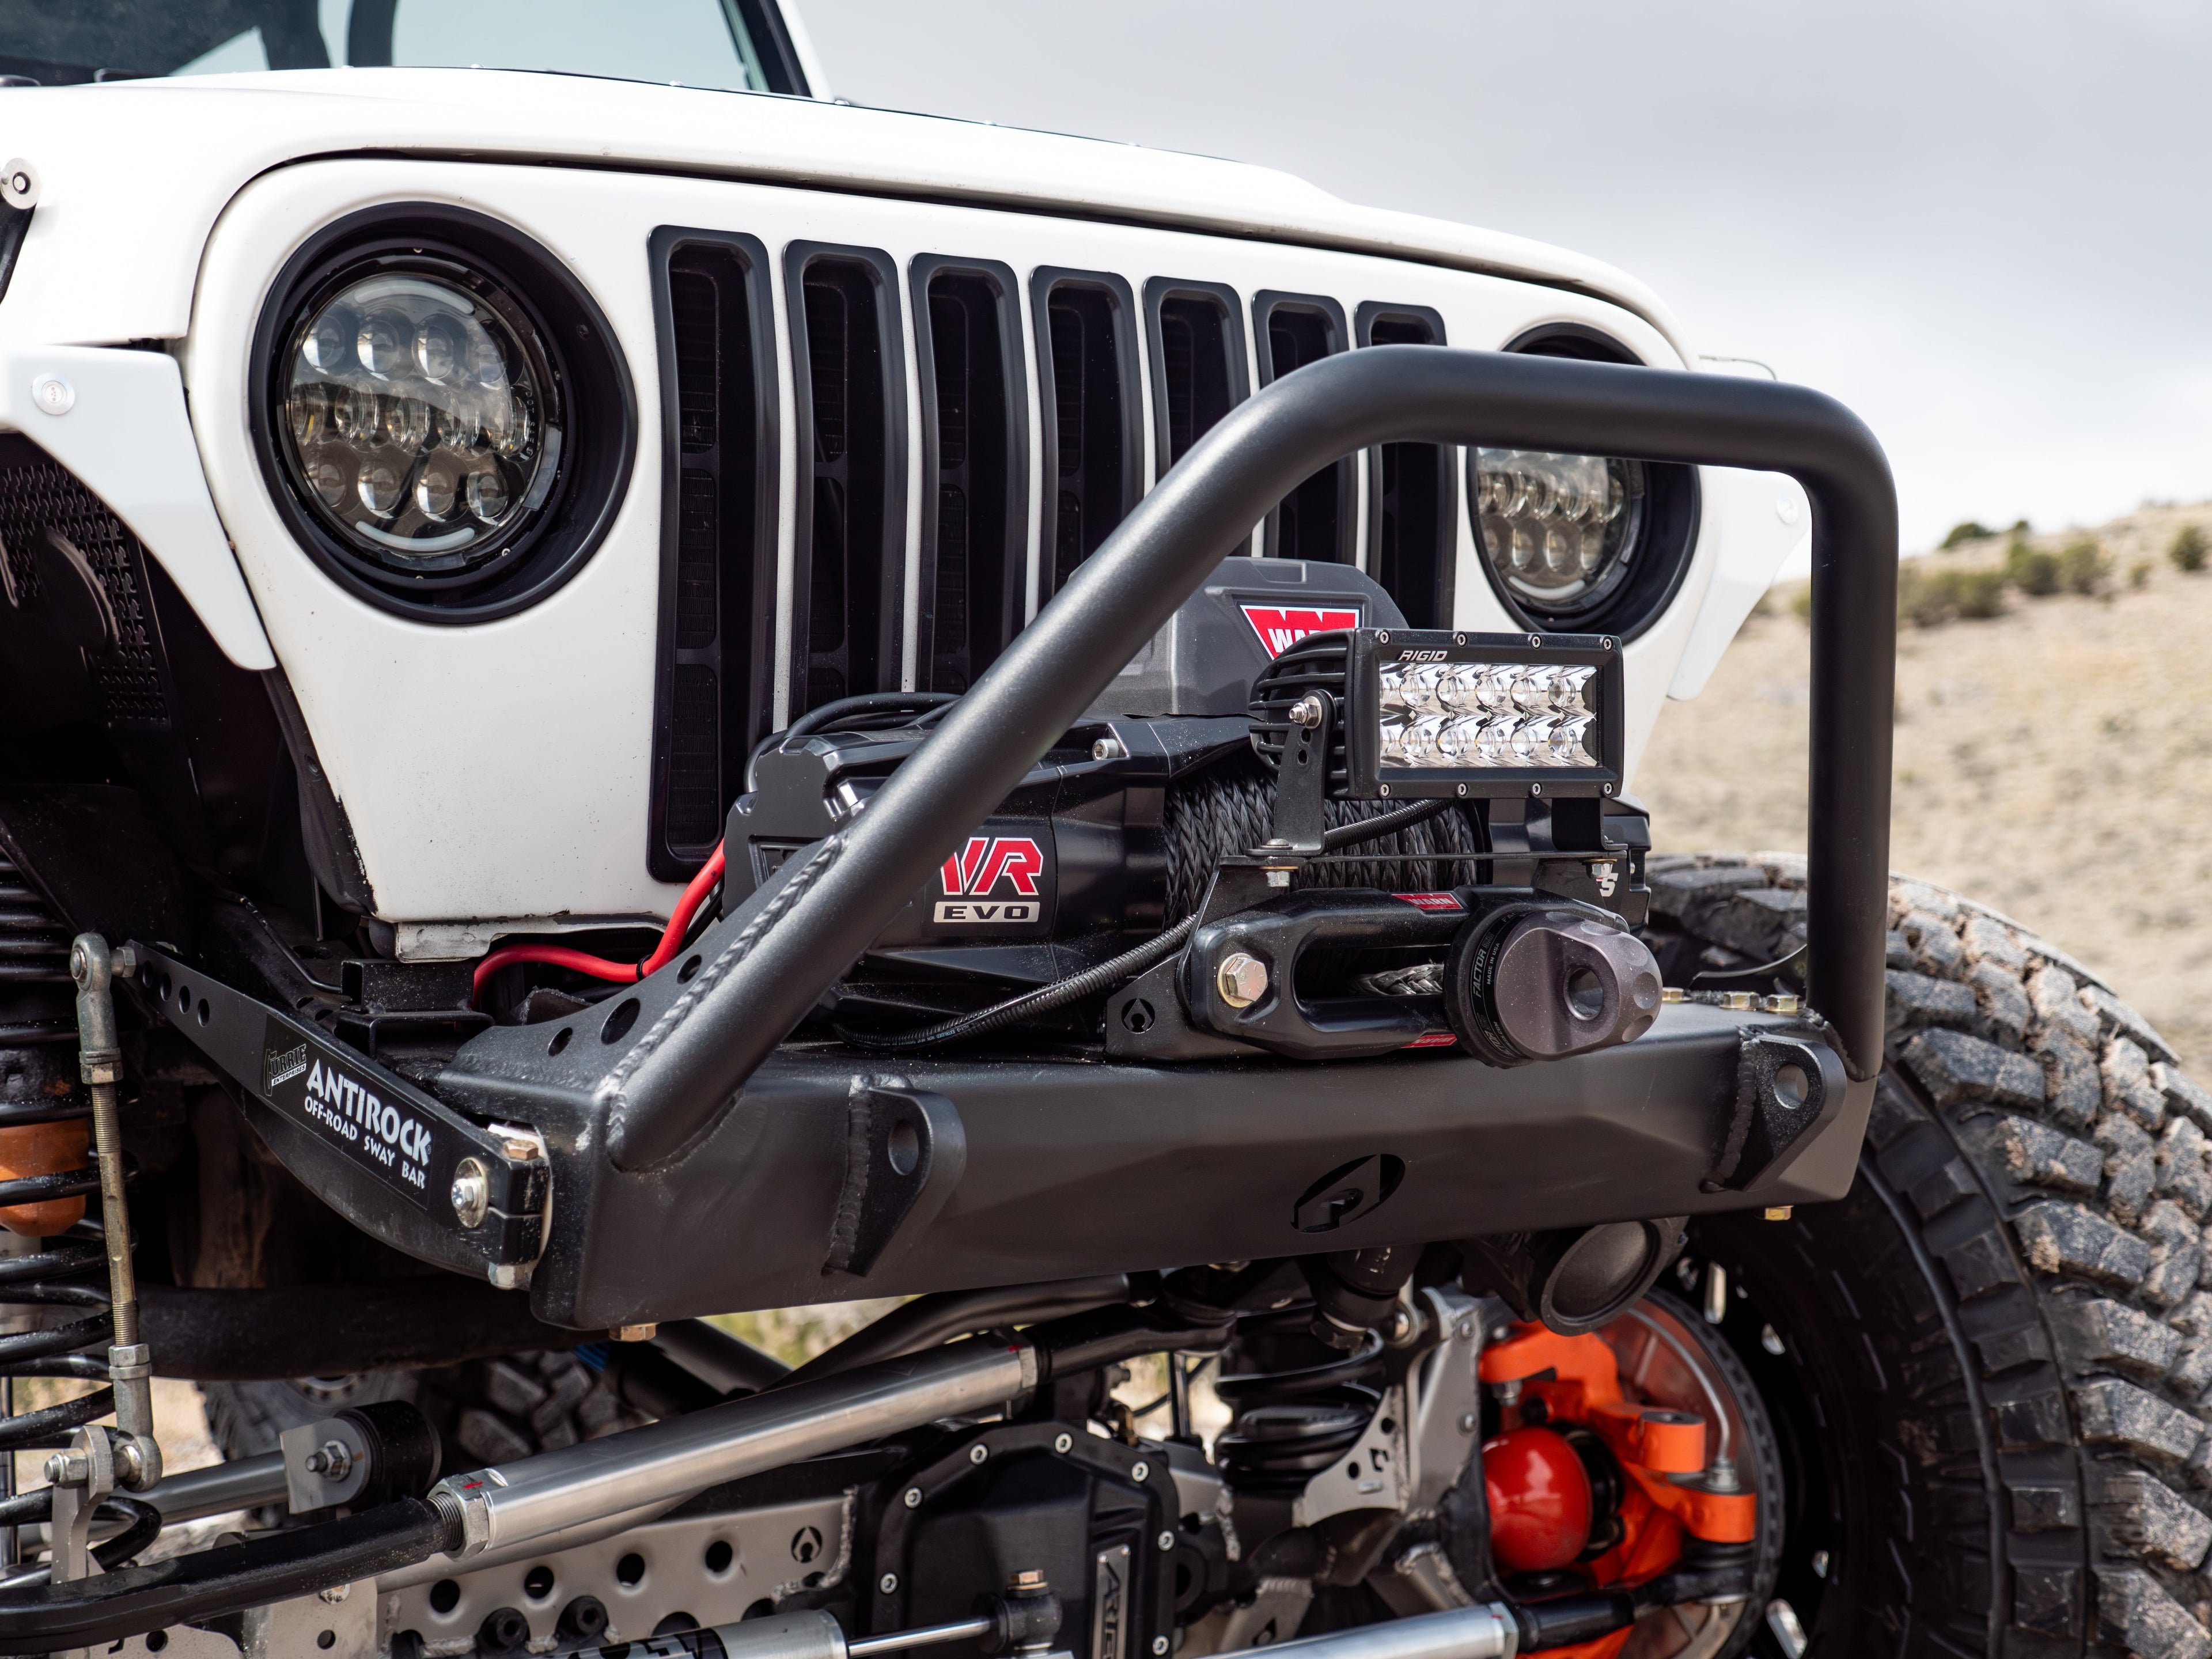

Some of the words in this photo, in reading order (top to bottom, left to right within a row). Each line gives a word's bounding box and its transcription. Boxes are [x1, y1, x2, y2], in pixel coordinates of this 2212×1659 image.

[525, 392, 535, 413] DOT
[1398, 650, 1448, 662] RIGID
[944, 905, 1030, 920] EVO
[1492, 942, 1500, 956] USA
[1490, 956, 1495, 964] IN
[1472, 948, 1487, 998] FACTOR
[263, 1043, 307, 1097] CURRIE
[271, 1063, 307, 1087] ENTERPRISES
[304, 1096, 358, 1141] OFF-ROAD
[363, 1136, 396, 1167] SWAY
[402, 1160, 427, 1190] BAR
